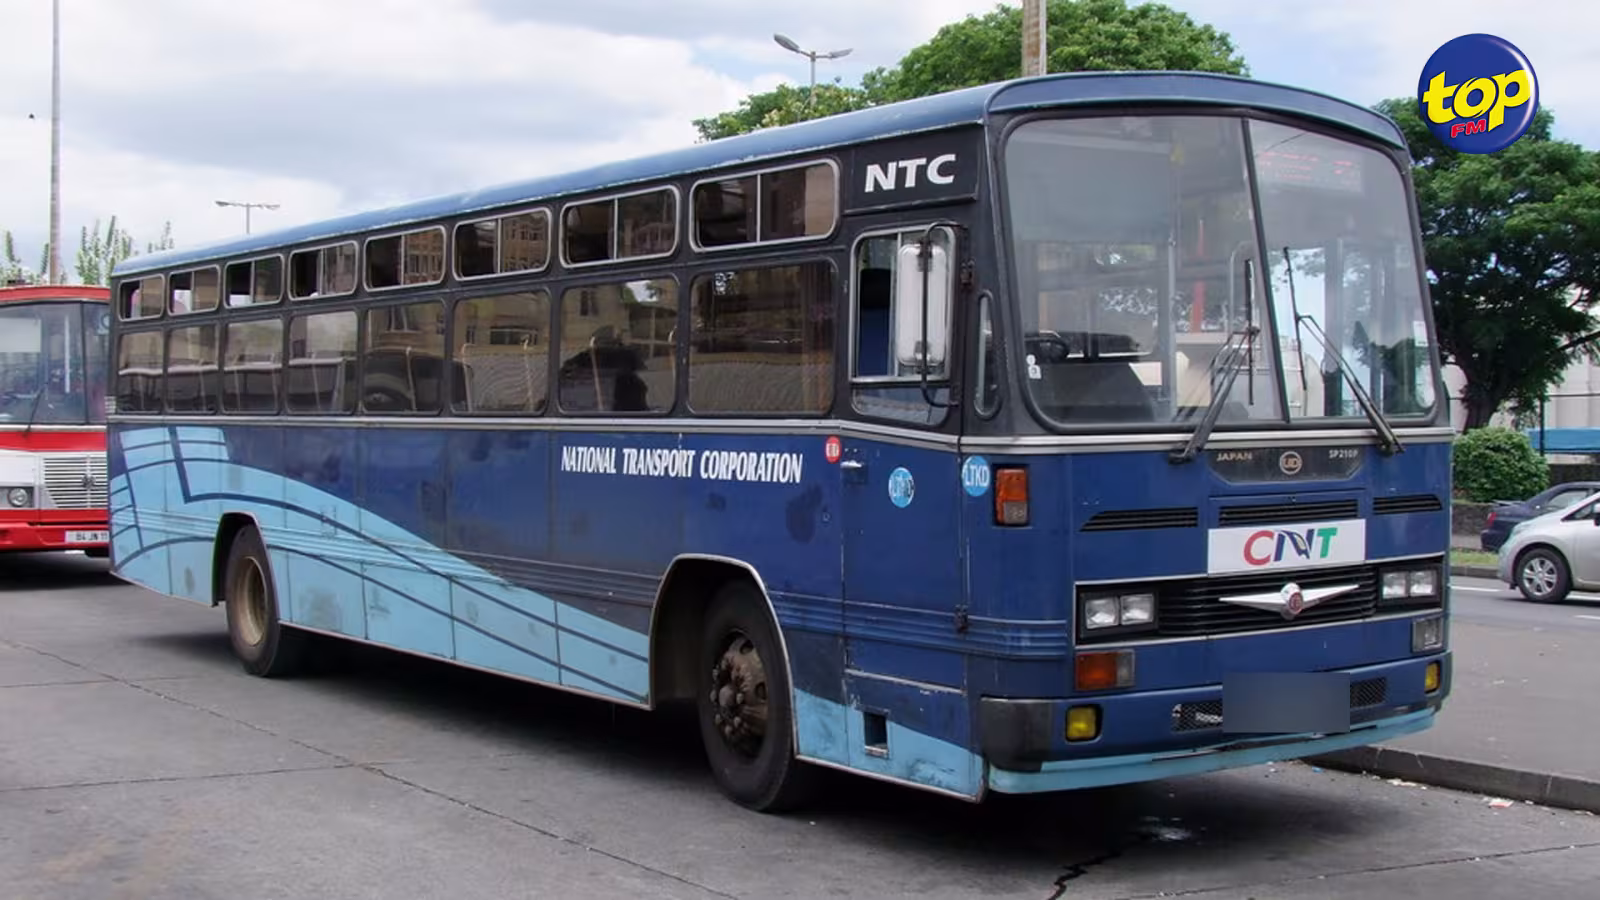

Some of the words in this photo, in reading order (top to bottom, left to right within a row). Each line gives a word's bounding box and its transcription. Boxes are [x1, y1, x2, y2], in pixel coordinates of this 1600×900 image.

[864, 153, 957, 193] NTC
[561, 446, 617, 474] NATIONAL
[622, 448, 696, 478] TRANSPORT
[700, 450, 804, 484] CORPORATION
[1216, 452, 1253, 462] JAPAN
[1243, 527, 1338, 566] CNT
